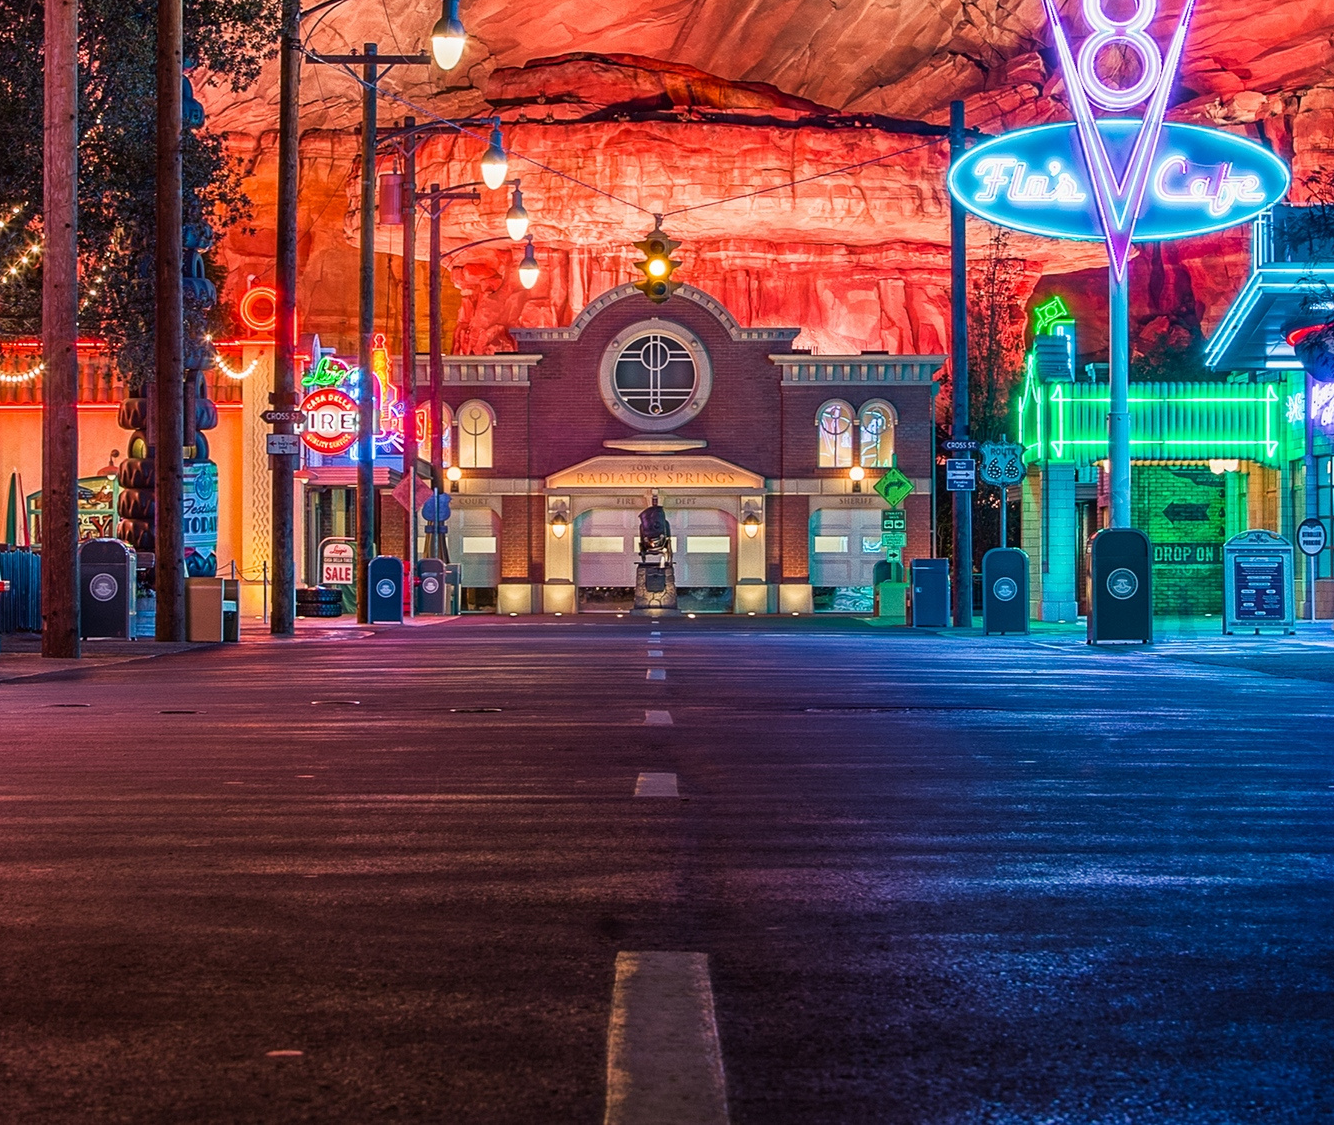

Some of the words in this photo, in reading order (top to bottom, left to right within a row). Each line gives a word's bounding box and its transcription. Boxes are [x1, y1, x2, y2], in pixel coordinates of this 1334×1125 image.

[975, 157, 1086, 202] Flo's
[1154, 156, 1266, 217] Cafe
[306, 394, 327, 410] CASA
[328, 394, 352, 410] DELLA
[294, 411, 359, 433] IRE
[946, 441, 967, 449] CROSS
[987, 458, 1019, 478] 66
[576, 472, 661, 484] RADIATOR
[667, 472, 736, 484] SPRINGS
[617, 497, 636, 505] FIRE
[675, 497, 697, 505] DEPT
[839, 497, 873, 505] SHERIFF
[1154, 546, 1192, 562] DROP
[1196, 546, 1213, 562] ON
[325, 566, 351, 581] SALE
